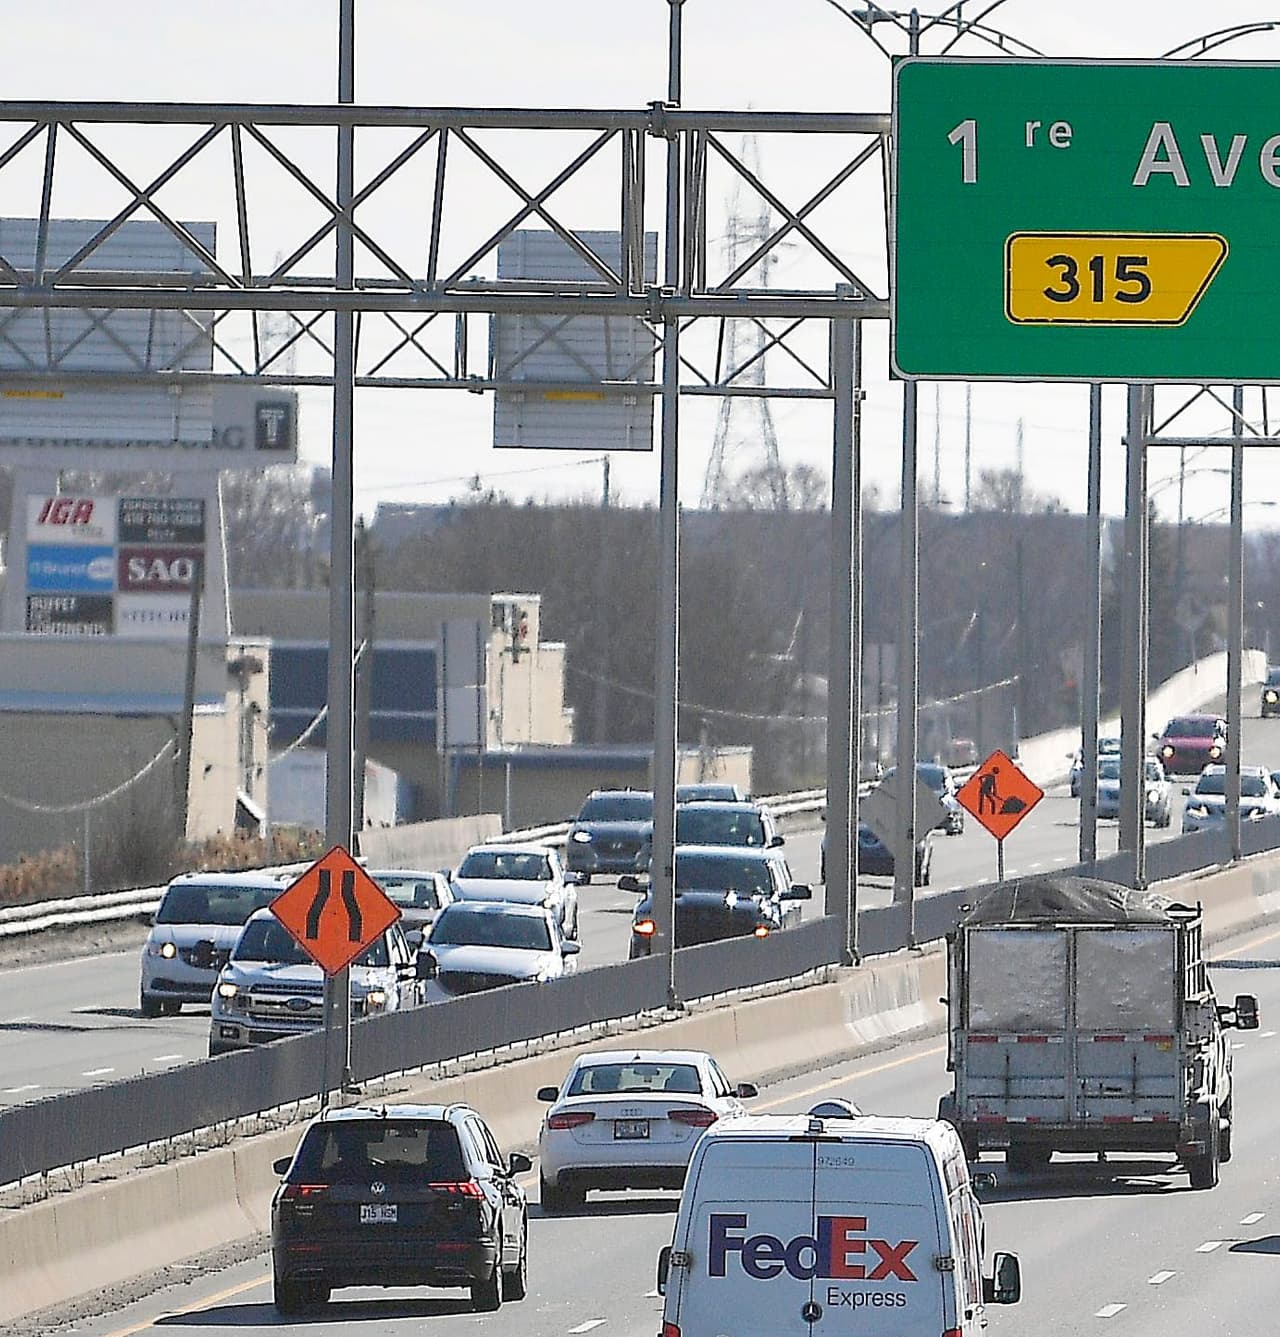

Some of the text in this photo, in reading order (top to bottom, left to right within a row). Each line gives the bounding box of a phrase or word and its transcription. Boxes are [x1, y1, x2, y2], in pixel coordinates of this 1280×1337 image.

[947, 119, 980, 185] 1
[1023, 117, 1073, 149] re
[1043, 253, 1153, 304] 315
[37, 498, 95, 525] IGA
[707, 1213, 920, 1282] FedEx
[826, 1286, 908, 1309] Express
